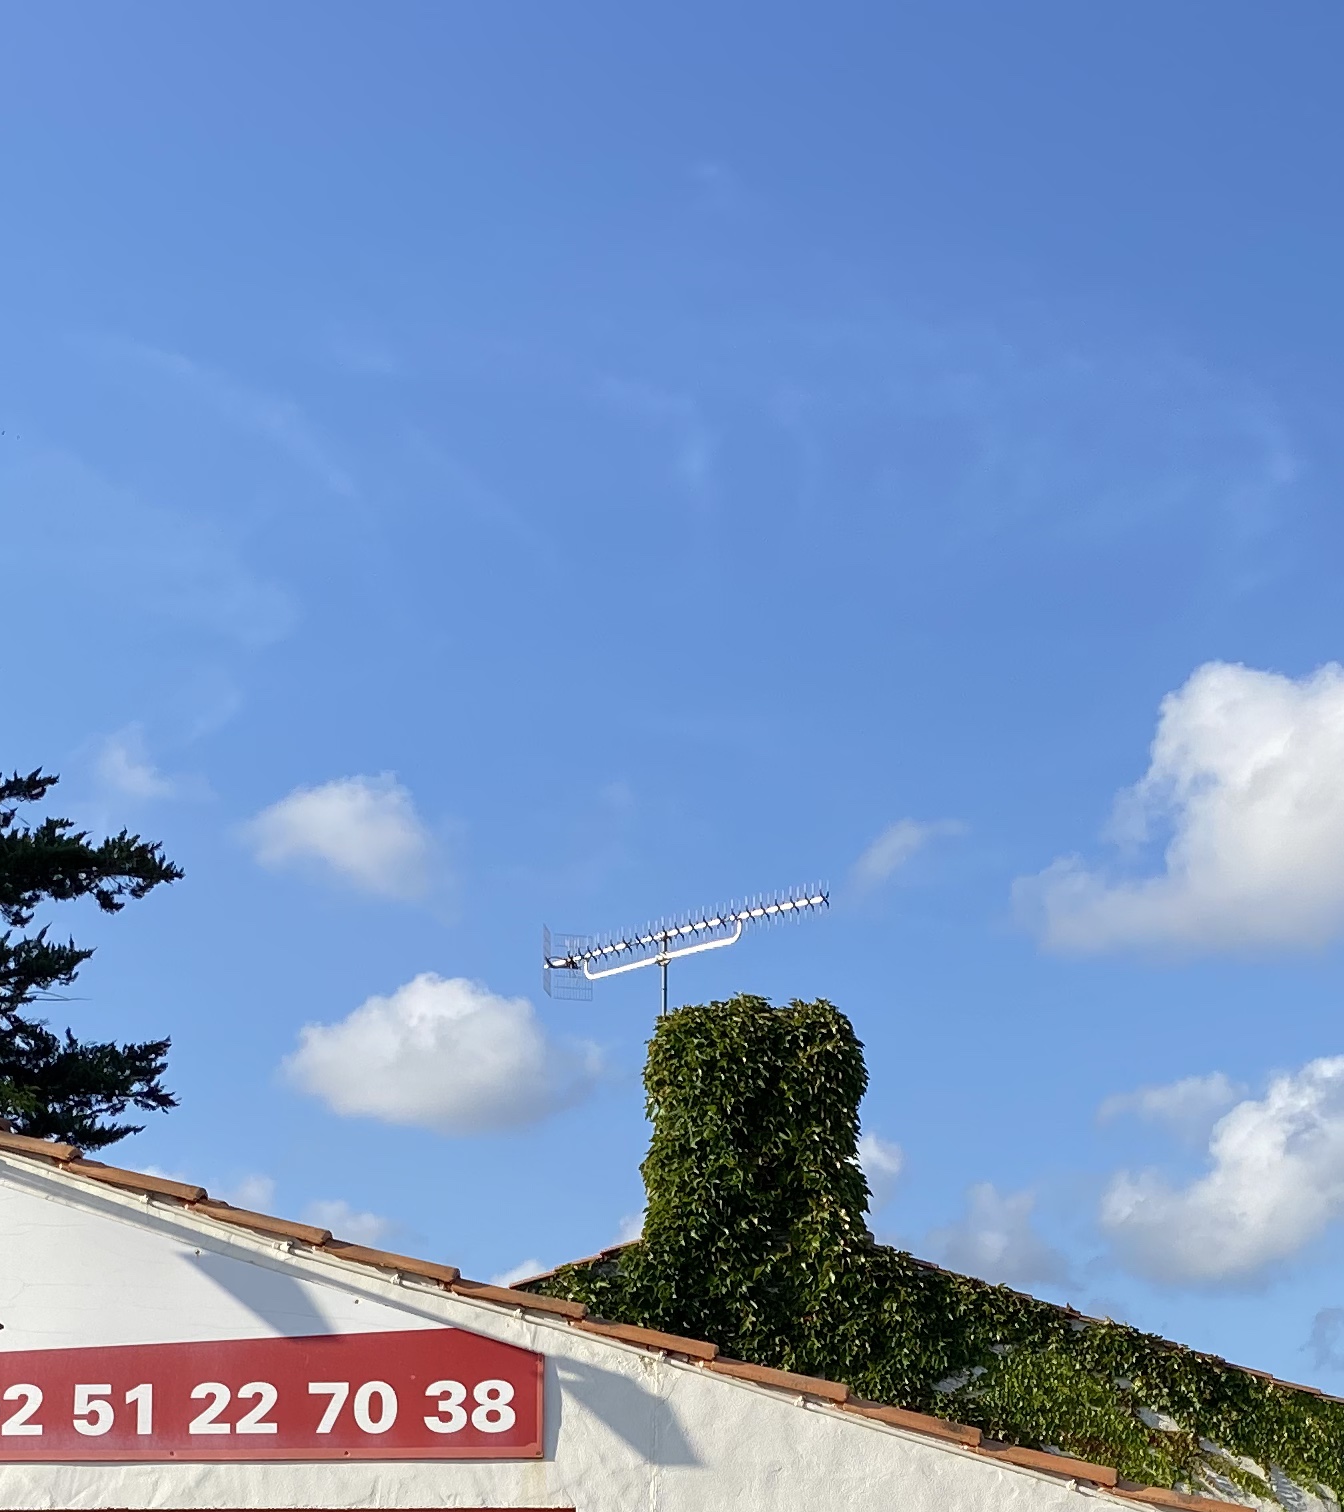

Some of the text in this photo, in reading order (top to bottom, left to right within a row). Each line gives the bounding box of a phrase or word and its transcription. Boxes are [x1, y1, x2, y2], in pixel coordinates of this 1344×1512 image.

[71, 1383, 154, 1436] 51
[188, 1381, 279, 1436] 22
[306, 1380, 398, 1435] 70
[422, 1379, 517, 1434] 38
